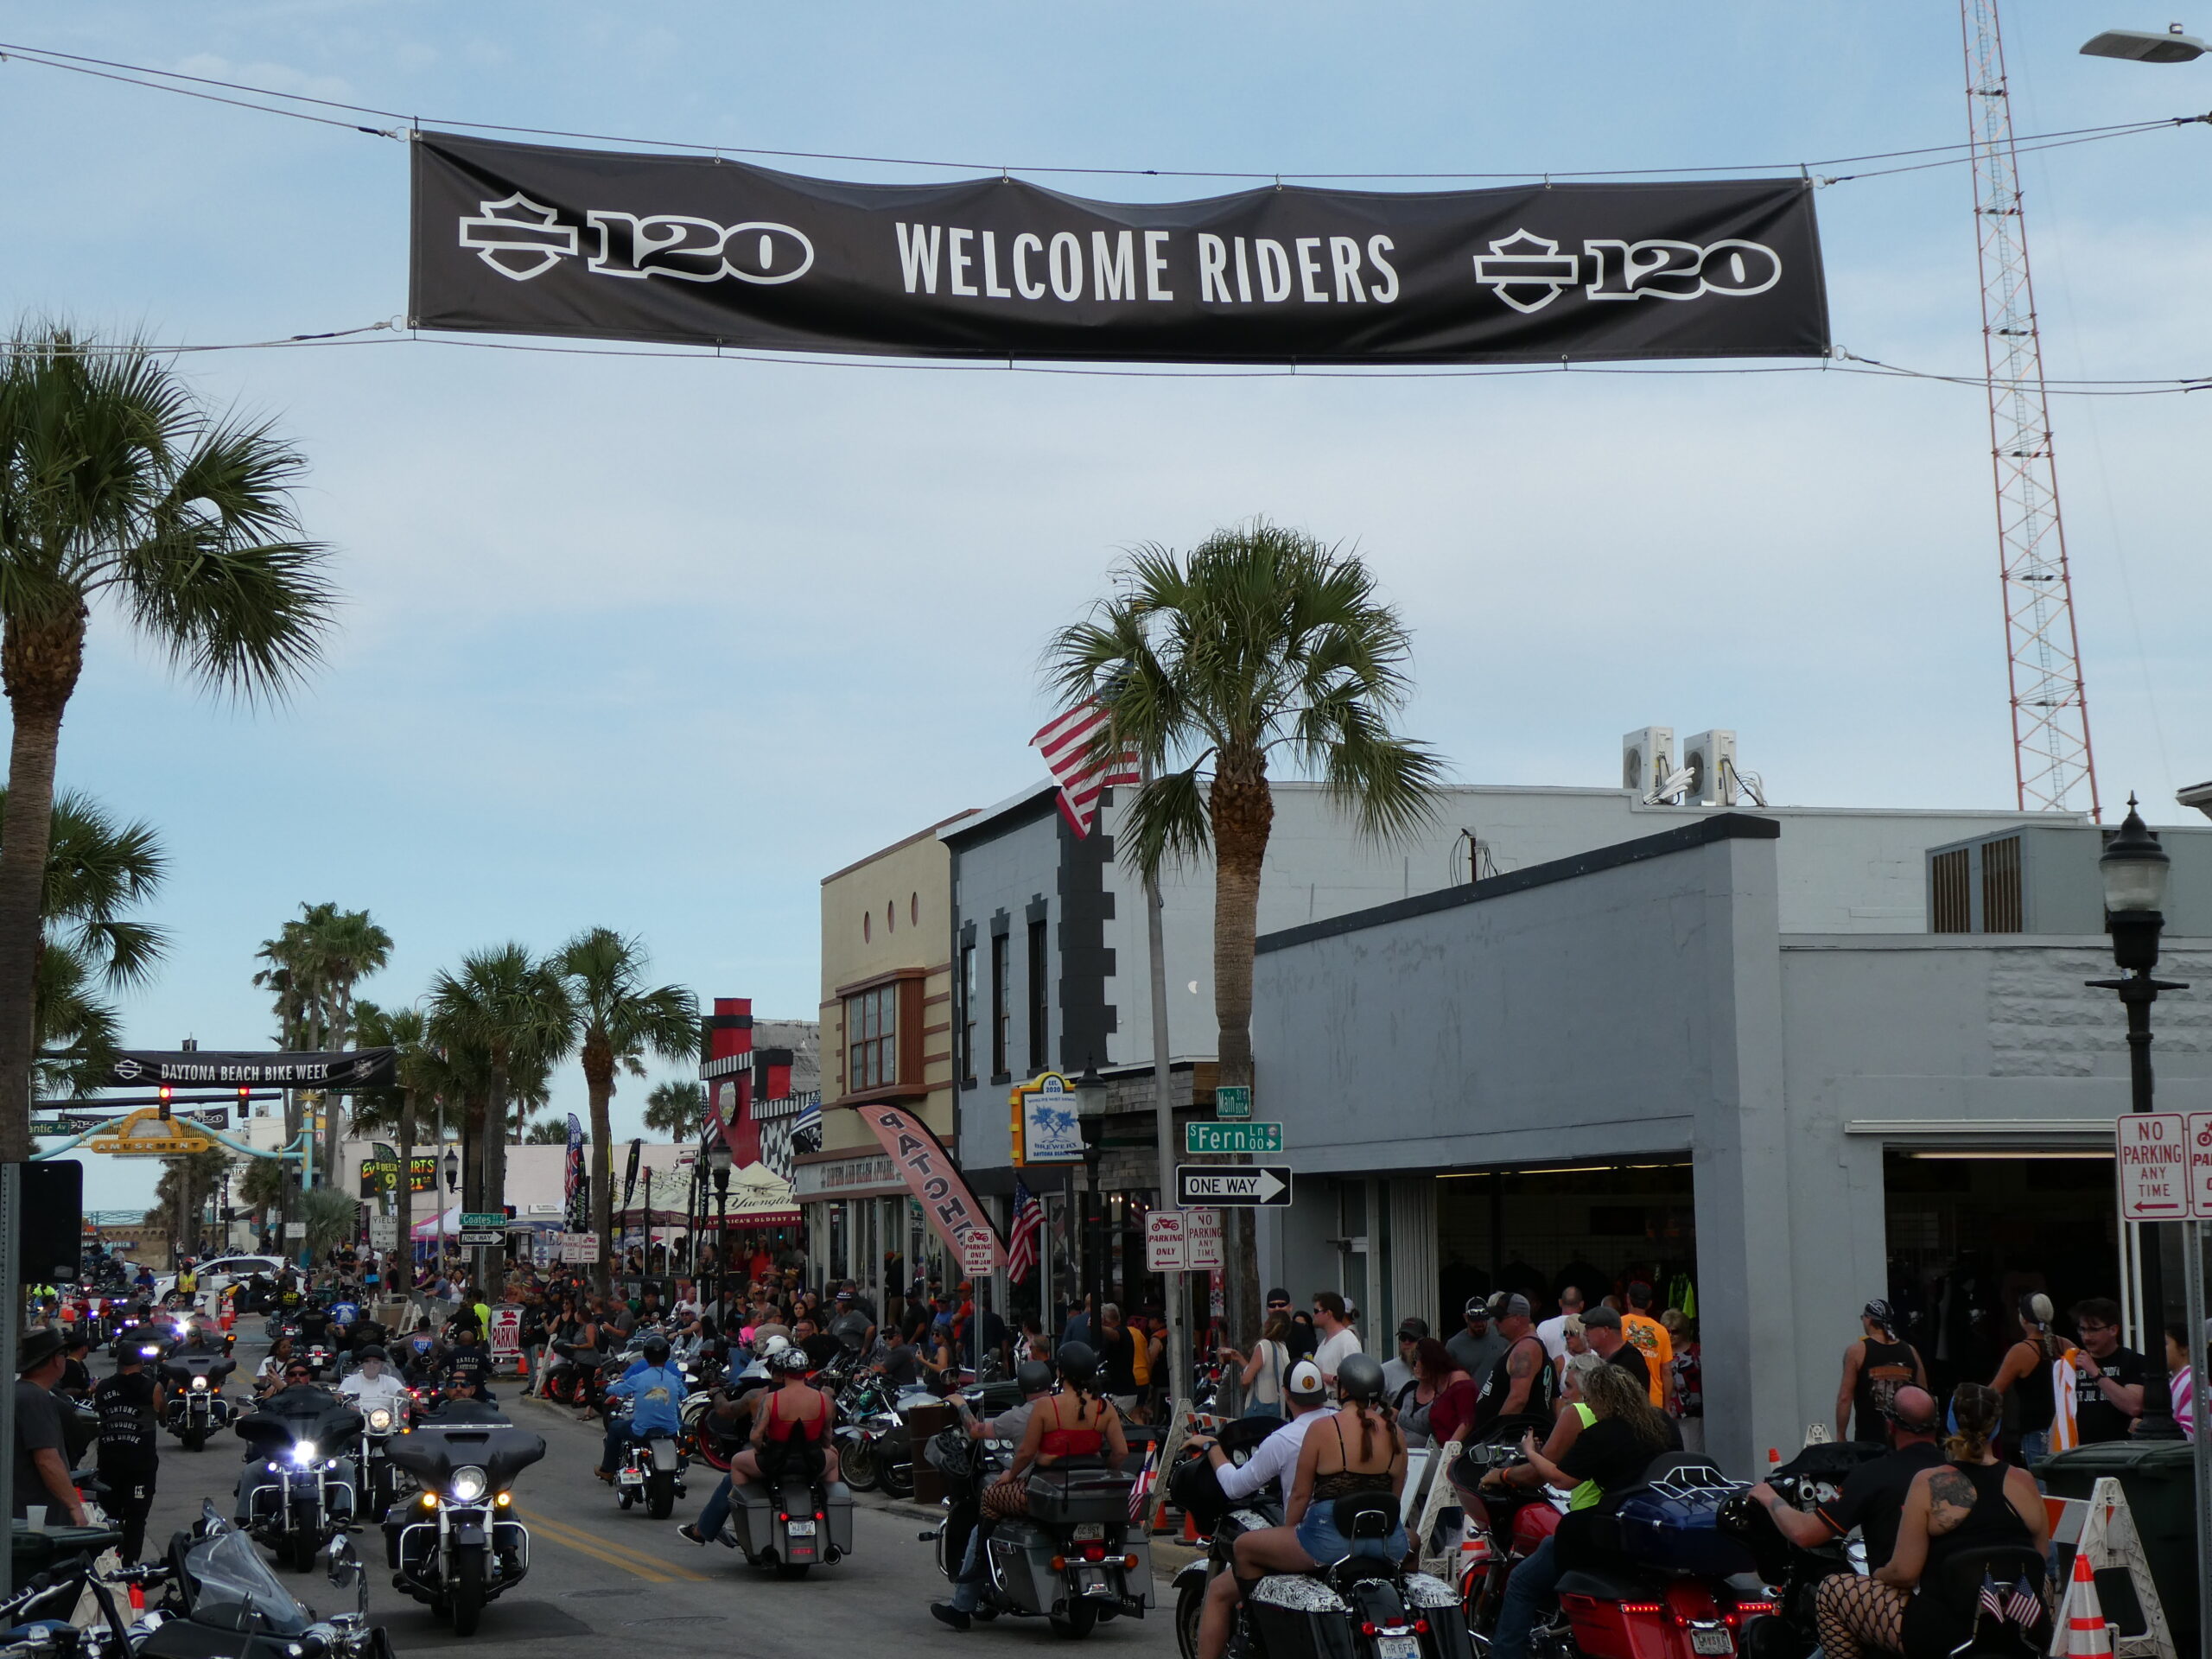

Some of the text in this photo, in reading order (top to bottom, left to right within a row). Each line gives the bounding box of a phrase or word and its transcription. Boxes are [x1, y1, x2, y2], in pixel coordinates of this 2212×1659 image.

[588, 210, 814, 285] 120
[895, 222, 1400, 303] WELCOME RIDERS
[1585, 238, 1782, 301] 120
[161, 1064, 329, 1081] DAYTONA BEACH BIKE WEEK
[1217, 1090, 1243, 1114] Main St
[1236, 1103, 1244, 1114] 800
[29, 1123, 53, 1134] antic
[2138, 1122, 2164, 1141] NO
[1190, 1125, 1263, 1149] S Fern Ln
[2123, 1144, 2182, 1165] PARKING
[2141, 1166, 2166, 1180] ANY
[1190, 1179, 1257, 1193] ONE WAY
[2138, 1184, 2171, 1198] TIME
[726, 1195, 793, 1211] Yuenglin
[463, 1215, 491, 1224] Coates
[1198, 1215, 1212, 1225] NO
[1148, 1234, 1184, 1243] PARKING
[1189, 1227, 1223, 1239] PARKING
[1198, 1249, 1216, 1257] TIME
[493, 1327, 520, 1349] PARKIN
[105, 1405, 138, 1416] FORTUNE
[1385, 1644, 1396, 1655] HR
